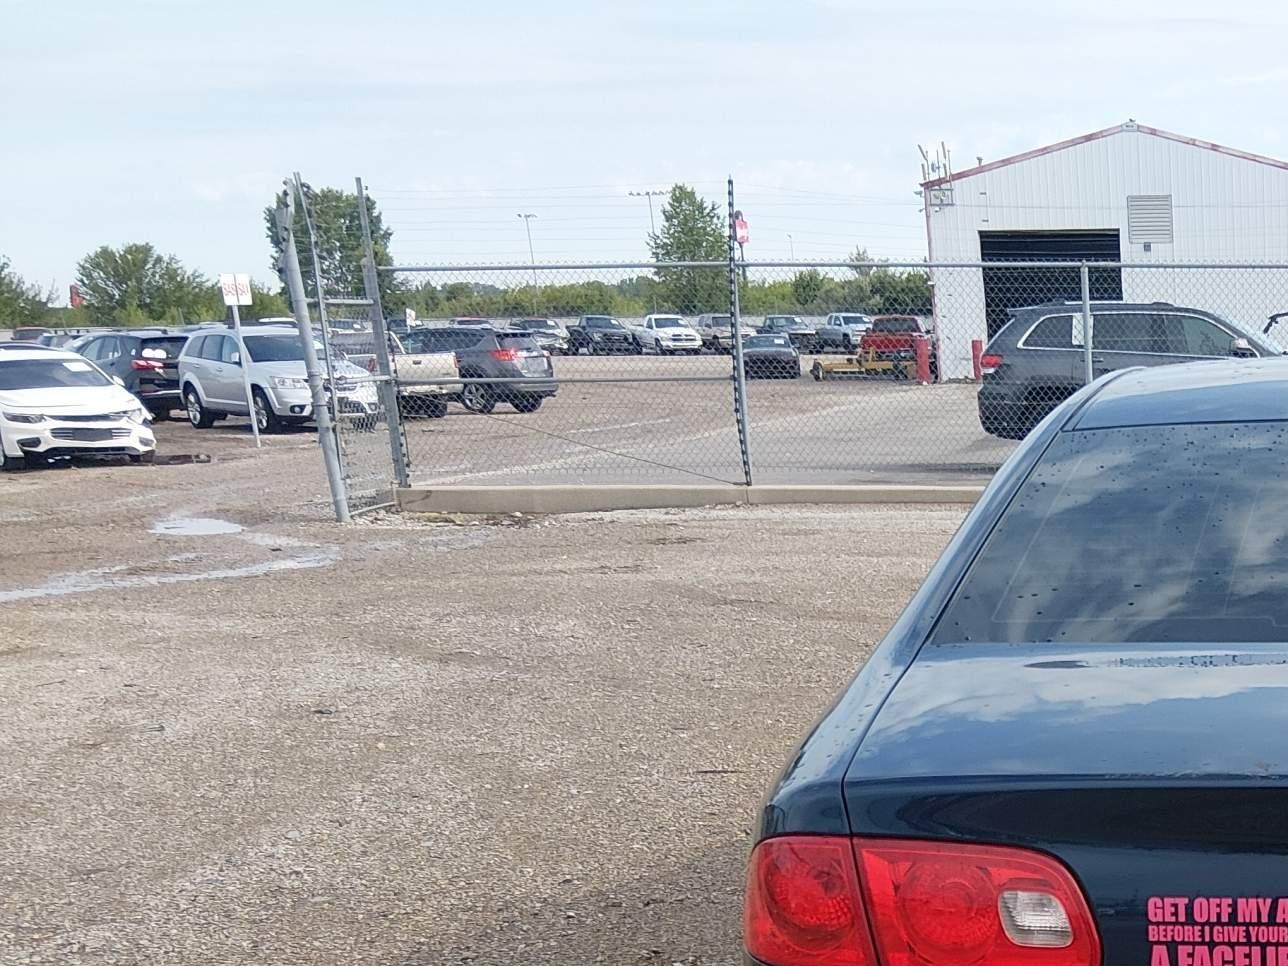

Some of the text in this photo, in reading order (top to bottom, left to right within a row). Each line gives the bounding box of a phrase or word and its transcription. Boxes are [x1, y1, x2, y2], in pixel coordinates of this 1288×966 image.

[1147, 897, 1188, 922] GET
[1193, 898, 1233, 923] OFF
[1237, 898, 1272, 923] MY
[1148, 925, 1202, 942] BEFORE
[1204, 925, 1211, 942] I
[1213, 926, 1248, 943] GIVE
[1249, 926, 1288, 943] YOUR
